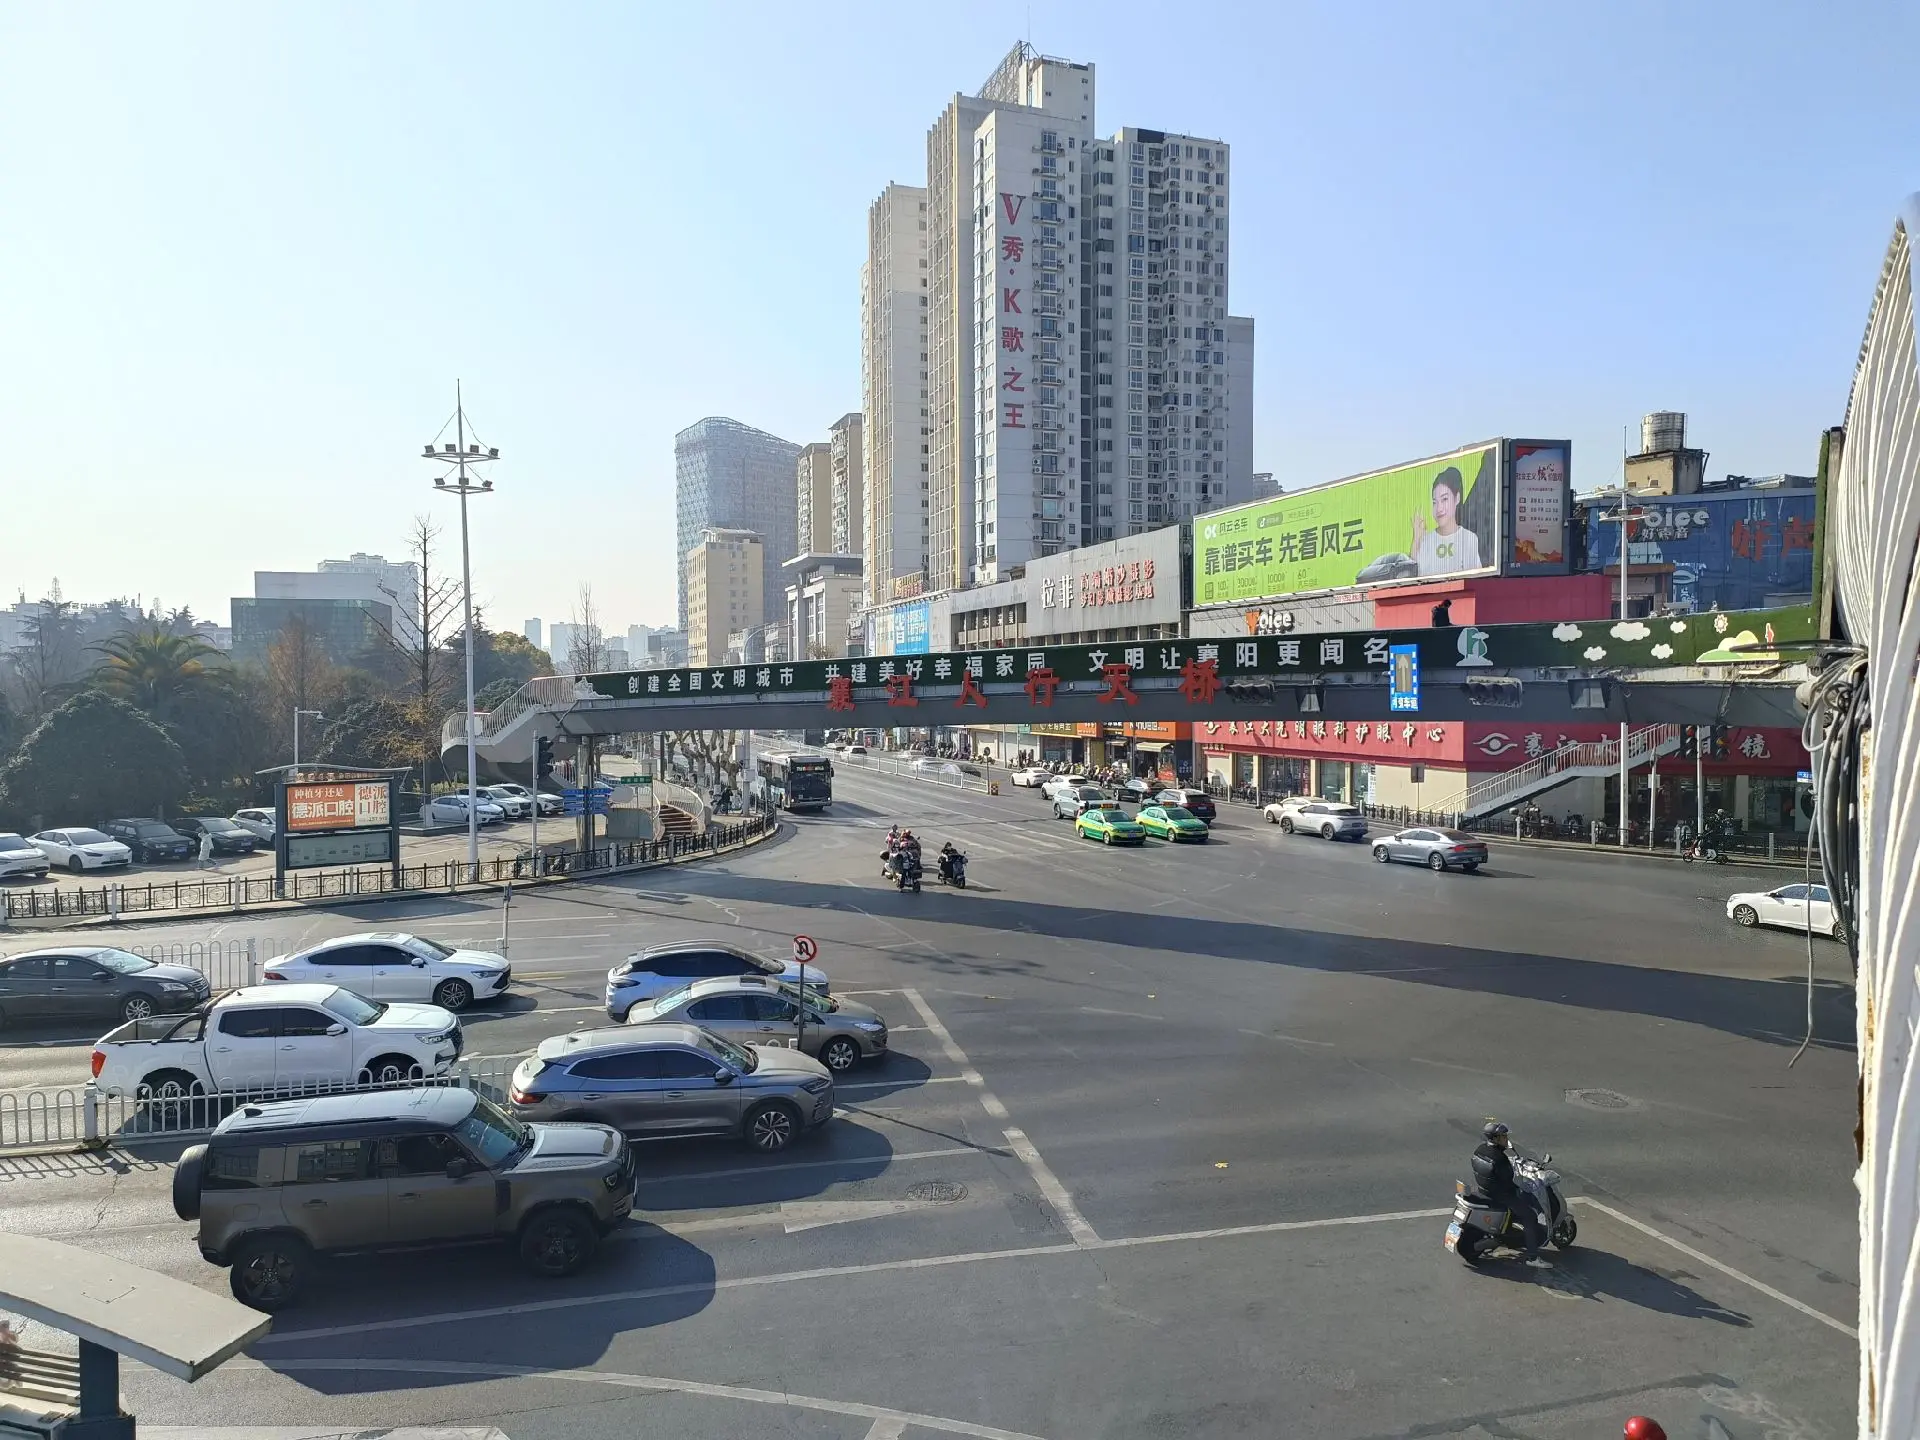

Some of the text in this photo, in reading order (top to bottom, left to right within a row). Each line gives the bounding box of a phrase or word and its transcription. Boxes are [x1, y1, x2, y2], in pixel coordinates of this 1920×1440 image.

[1205, 536, 1273, 575] 靠谱买车
[1278, 518, 1364, 563] 先看风云
[1041, 574, 1074, 609] 拉菲
[628, 637, 1388, 694] 创建全国文明城市 共建美好幸福家园 文明让襄阳更闻名
[827, 658, 1222, 712] 襄江人行天桥
[294, 787, 344, 800] 种植牙还是
[358, 785, 387, 801] 德派
[291, 799, 354, 819] 德派口腔
[358, 800, 387, 815] 口腔
